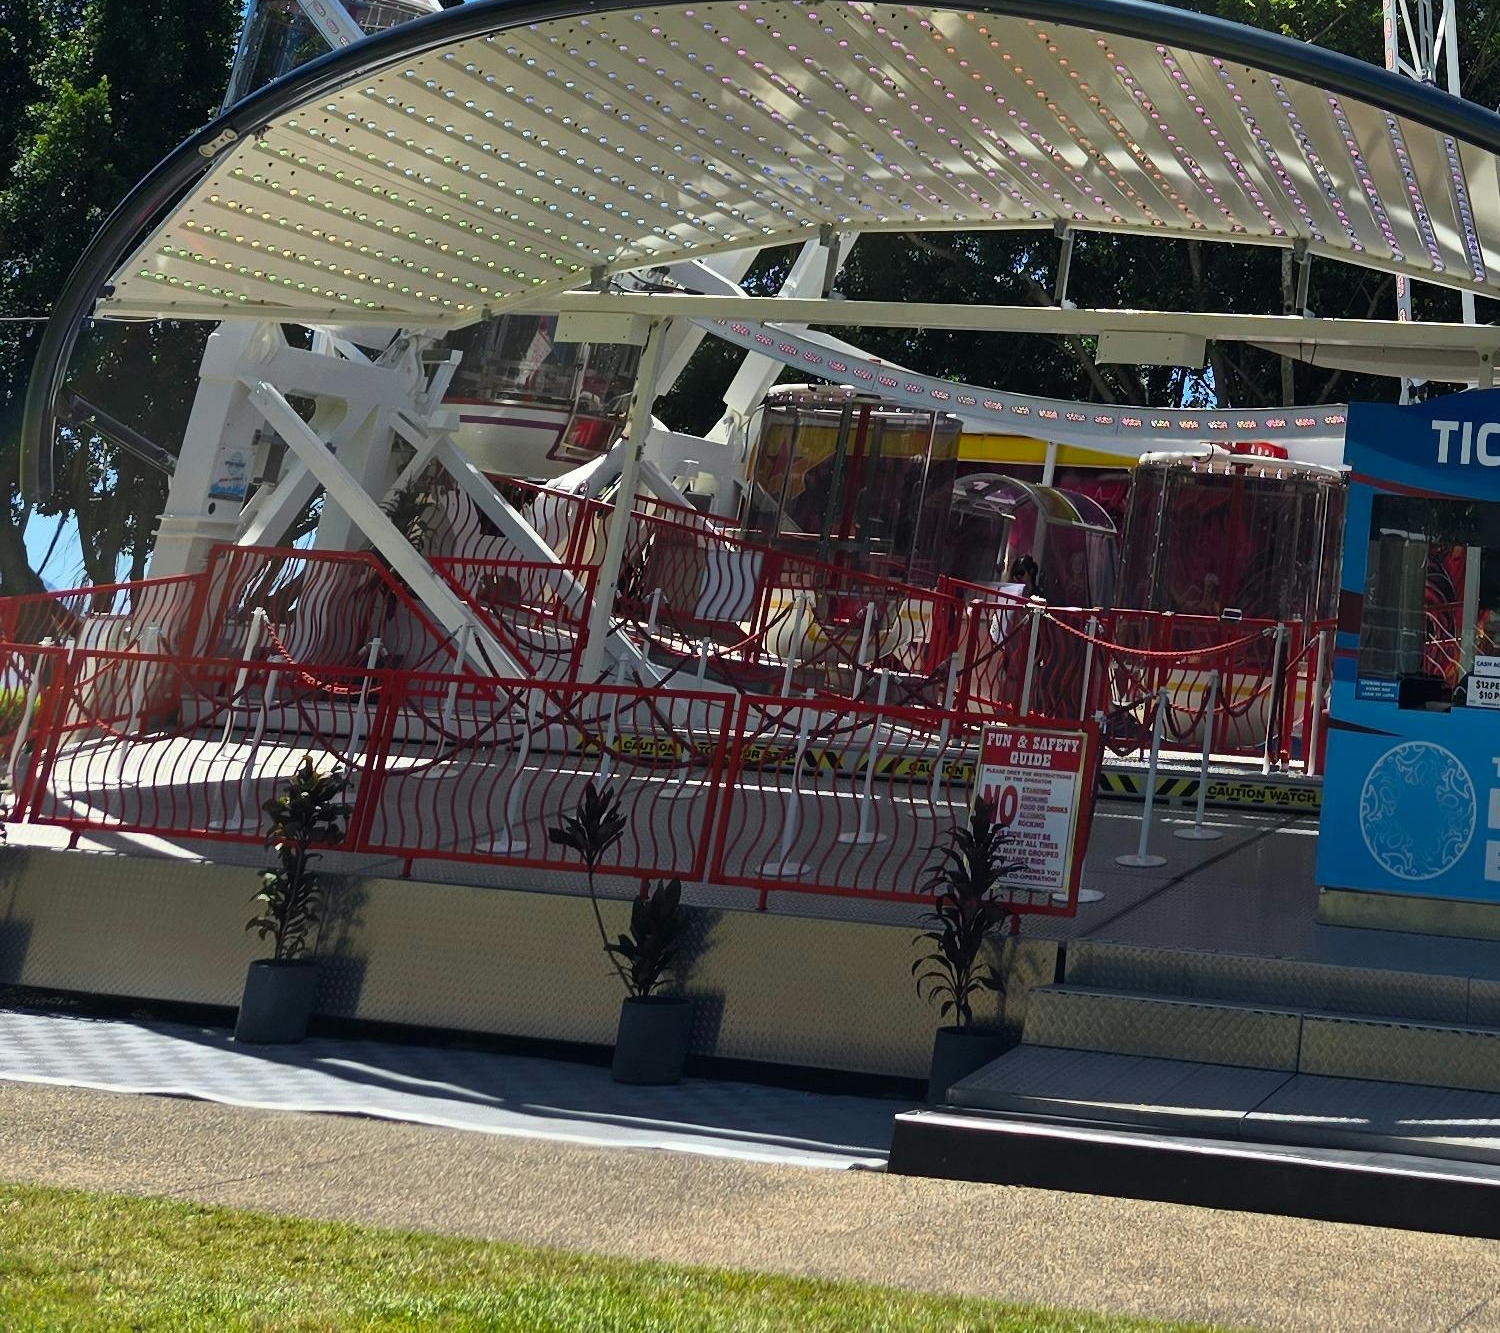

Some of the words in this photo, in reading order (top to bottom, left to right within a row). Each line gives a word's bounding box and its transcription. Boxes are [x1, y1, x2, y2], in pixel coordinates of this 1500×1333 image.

[1476, 660, 1492, 668] CASH
[1475, 680, 1489, 690] $12
[1478, 690, 1493, 700] $10
[987, 733, 1013, 748] FUN
[1017, 735, 1028, 749] &
[1032, 736, 1080, 753] SAFETY
[1009, 751, 1052, 767] GUIDE
[1207, 785, 1266, 800] CAUTION
[1269, 790, 1317, 803] WATCH
[1023, 832, 1041, 840] MUST
[1039, 842, 1059, 850] TIMES
[1003, 847, 1017, 855] MAY
[1028, 849, 1060, 859] GROUPED
[1008, 873, 1057, 882] CO-OPERATION
